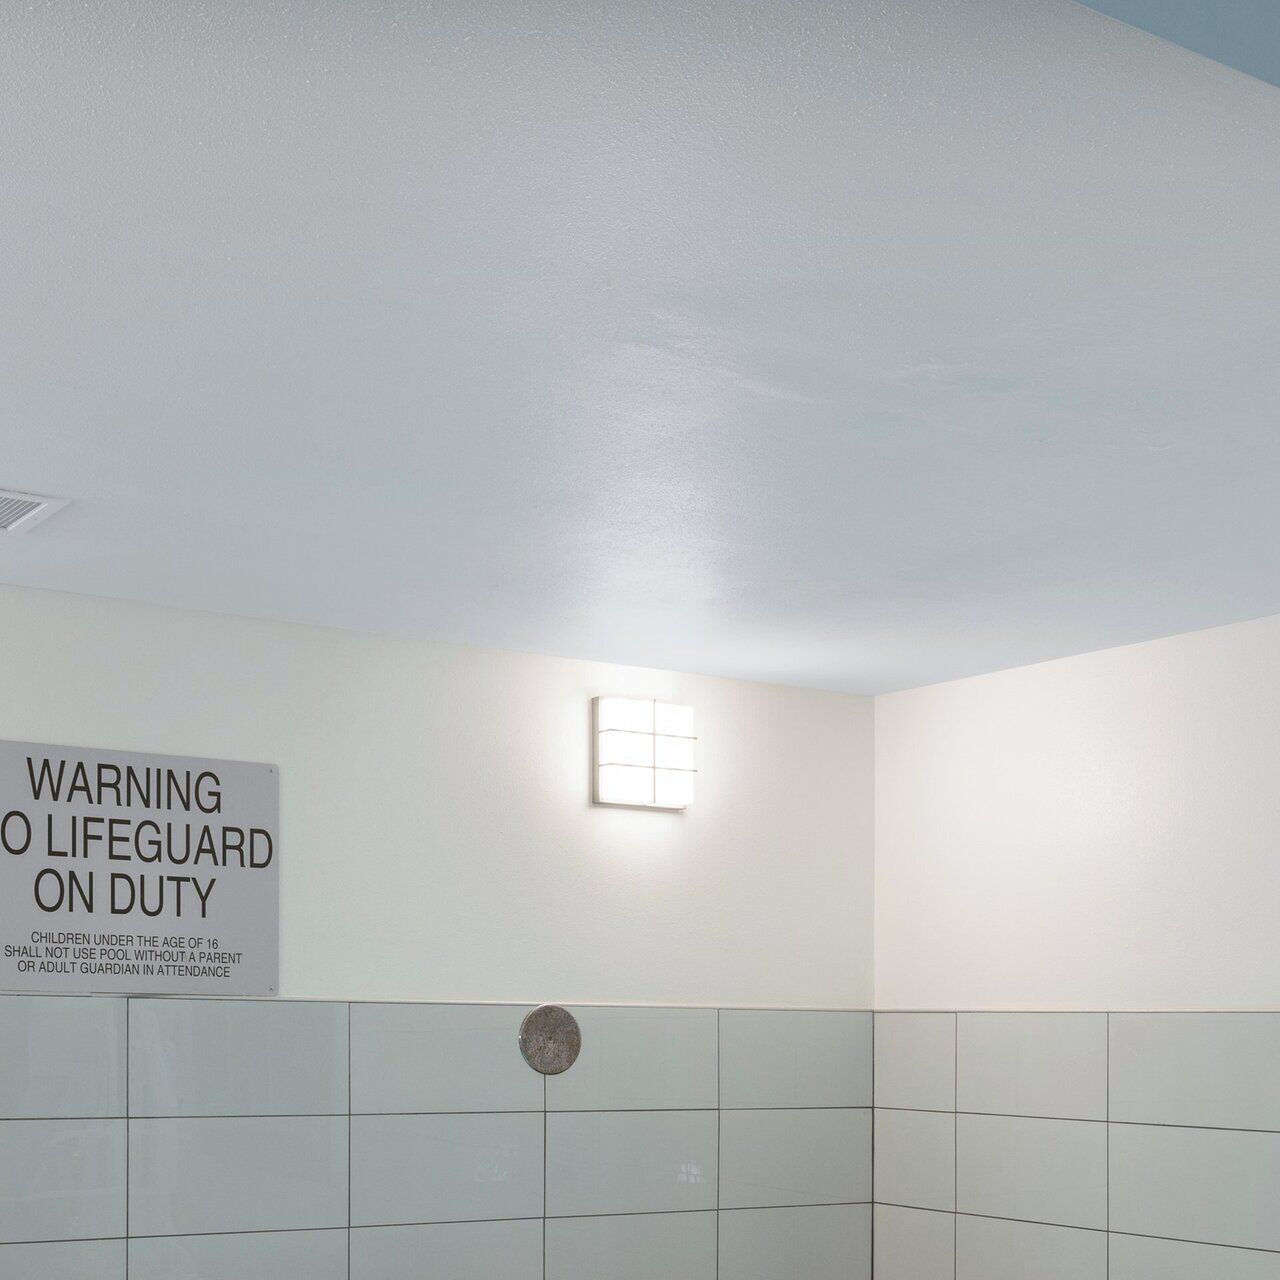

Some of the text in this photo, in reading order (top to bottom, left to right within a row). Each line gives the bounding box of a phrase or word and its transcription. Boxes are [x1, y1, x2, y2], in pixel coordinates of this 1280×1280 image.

[27, 757, 221, 813] WARNING
[47, 814, 273, 868] LIFEGUARD
[34, 868, 216, 918] ON DUTY
[4, 946, 242, 964] SHALL NOT USE POOL WITHOUT A PARENT
[31, 931, 218, 949] CHILDREN UNDER THE AGE OF 16
[17, 961, 230, 977] OR ADULT GUARDIAN IN ATTENDANCE
